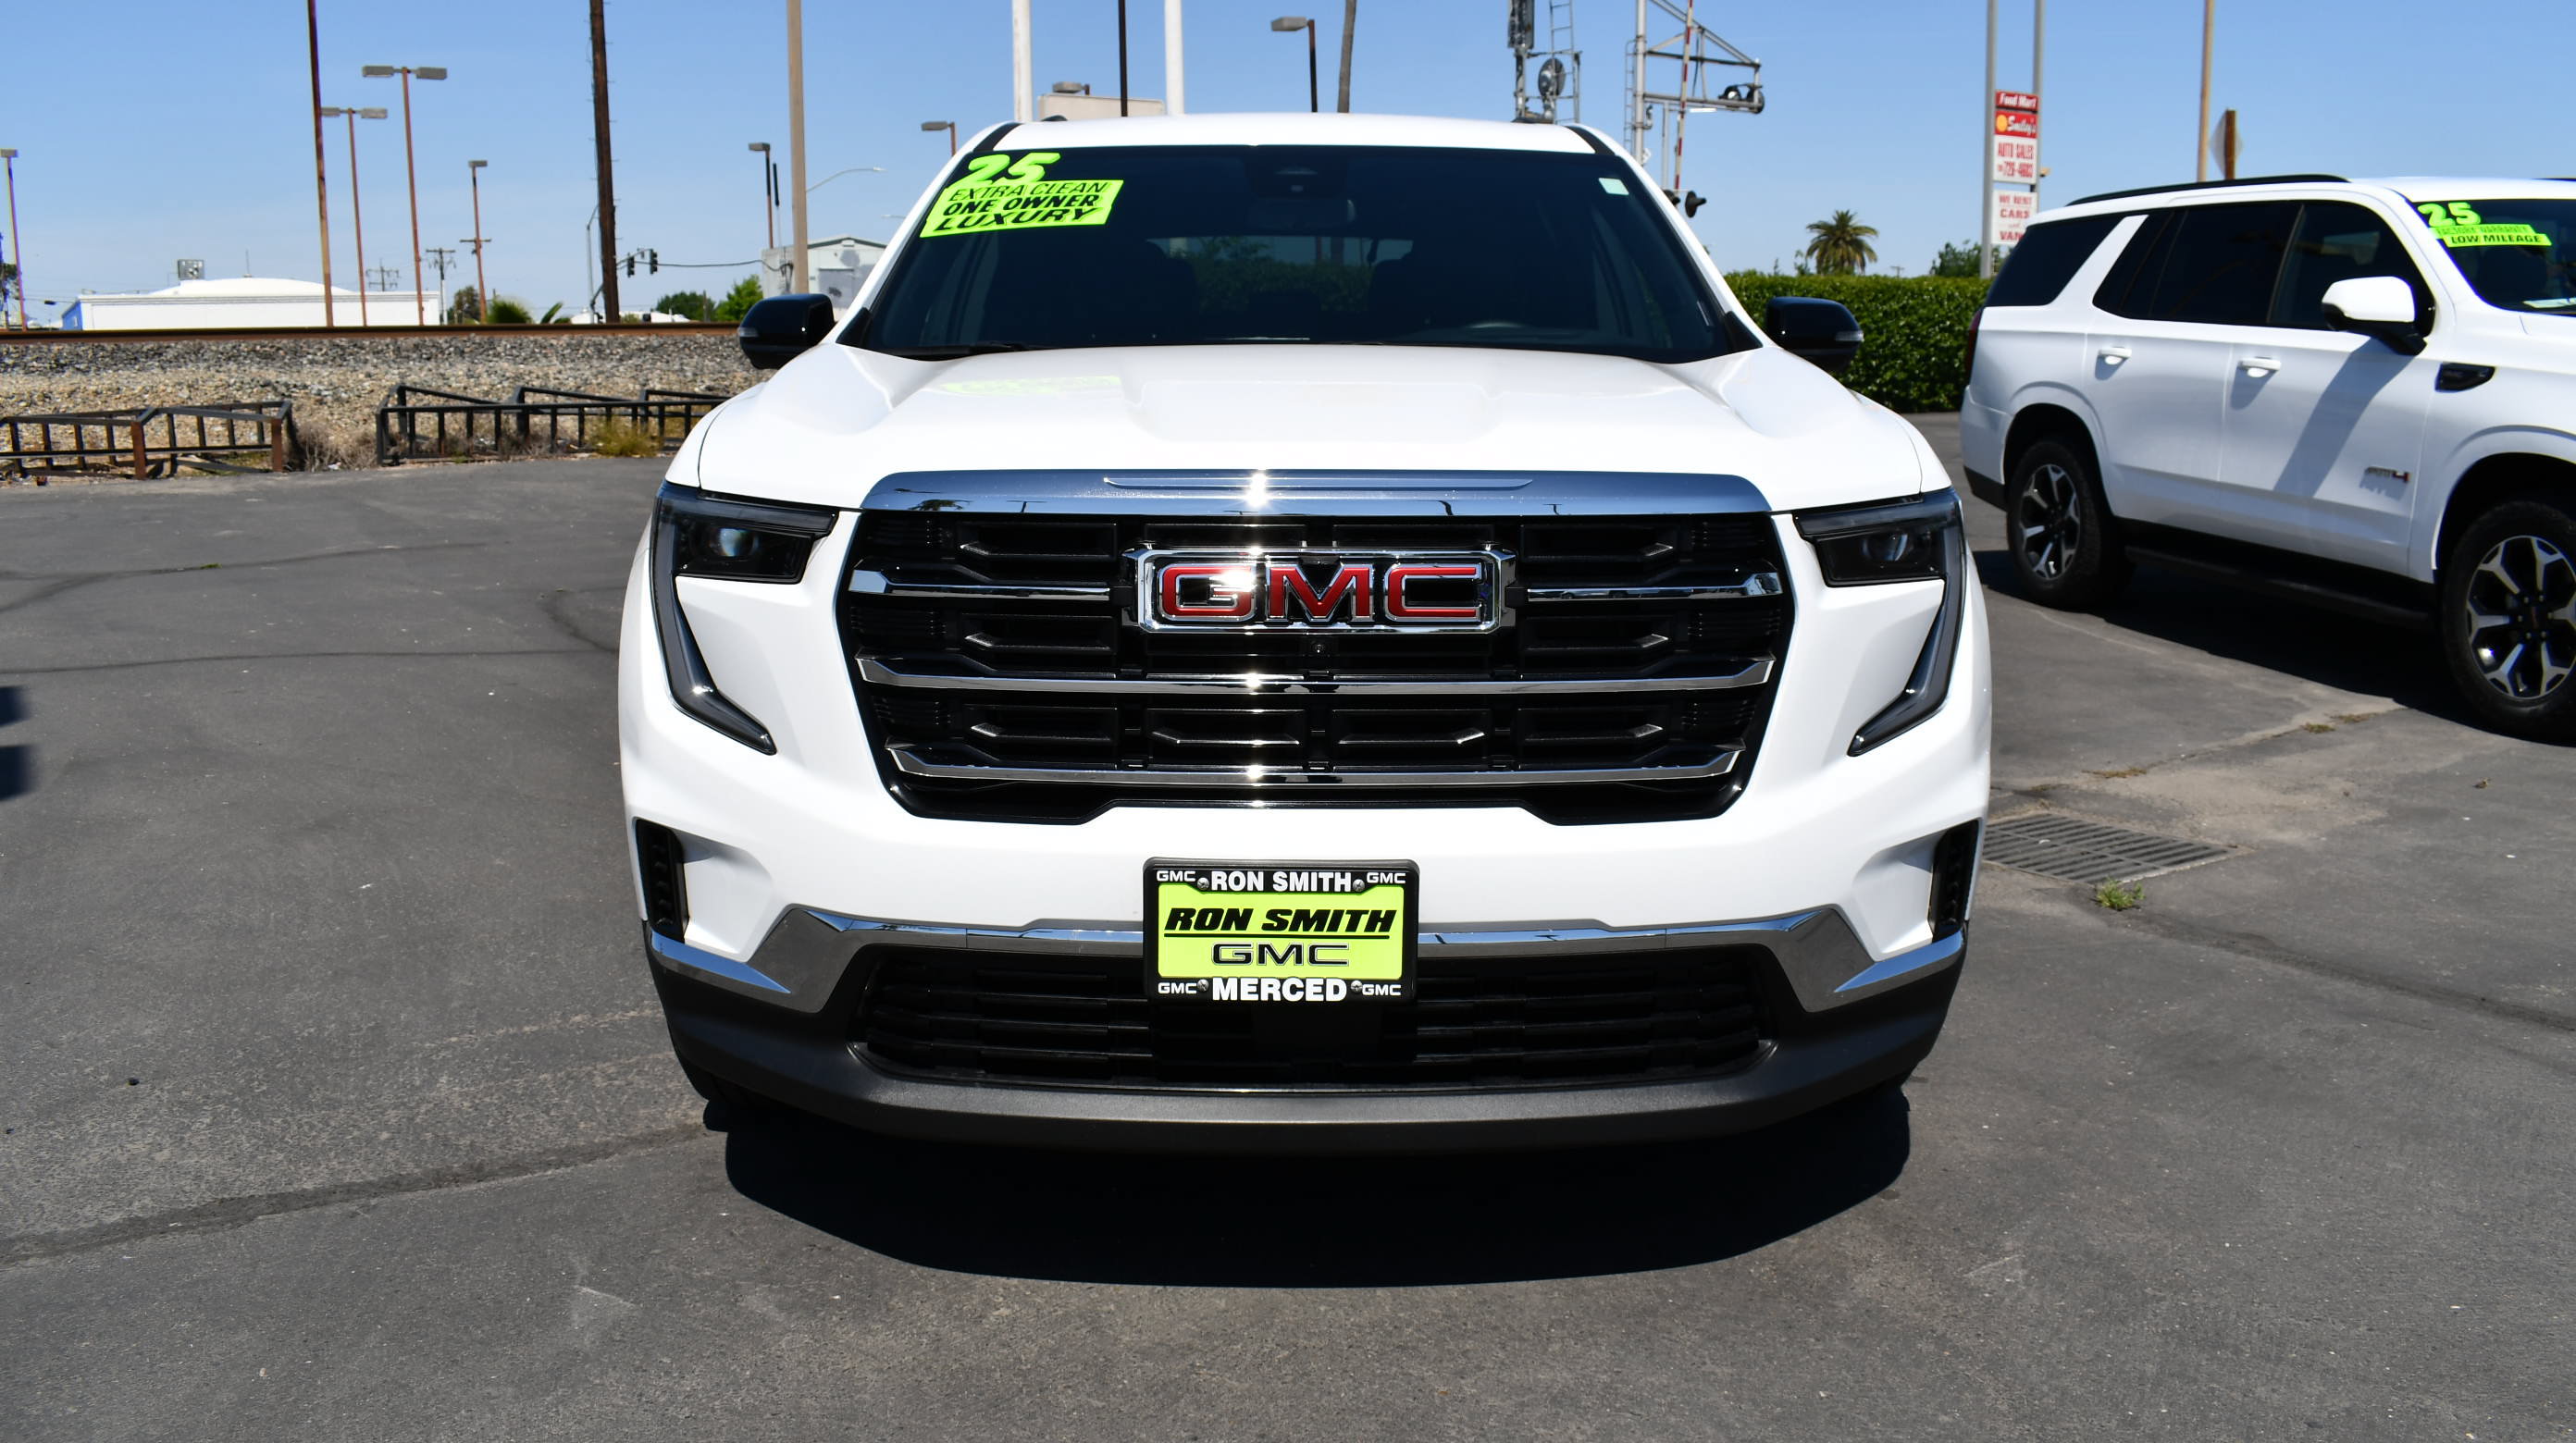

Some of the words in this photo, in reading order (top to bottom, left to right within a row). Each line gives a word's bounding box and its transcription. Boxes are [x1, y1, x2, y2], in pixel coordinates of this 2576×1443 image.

[1998, 142, 2013, 158] AUTO
[2016, 144, 2034, 160] SALES
[946, 153, 1061, 186] 25
[948, 183, 1024, 202] EXTRA
[1030, 181, 1108, 195] CLEAN
[943, 199, 1000, 216] ONE
[1003, 194, 1099, 210] OWNER
[2000, 209, 2030, 219] CARS
[2417, 202, 2482, 227] 25
[933, 207, 1098, 231] LUXURY
[2000, 230, 2025, 242] VAN
[2451, 235, 2479, 244] LOW
[2483, 234, 2542, 243] MILEAGE
[1159, 562, 1482, 623] GMC
[1157, 870, 1196, 882] GMC
[1211, 870, 1267, 892] RON
[1272, 871, 1352, 893] SMITH
[1366, 872, 1406, 884] GMC
[1164, 907, 1254, 931] RON
[1261, 908, 1397, 932] SMITH
[1211, 942, 1349, 967] GMC
[1158, 981, 1197, 994] GMC
[1212, 977, 1347, 1002] MERCED
[1361, 983, 1402, 996] GMC
